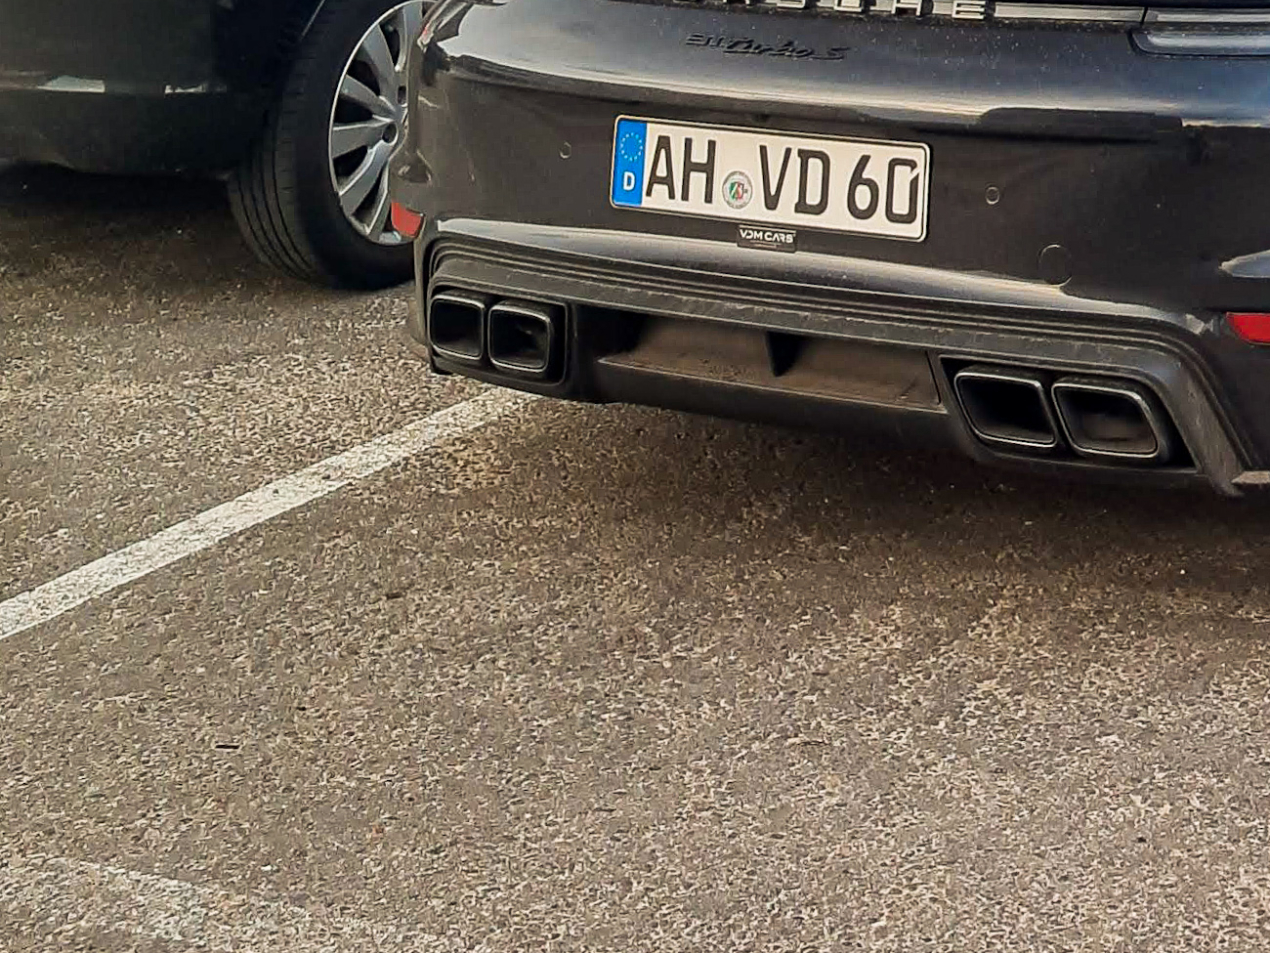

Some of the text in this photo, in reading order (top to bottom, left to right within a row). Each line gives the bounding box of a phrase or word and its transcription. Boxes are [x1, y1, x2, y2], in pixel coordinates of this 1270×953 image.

[623, 171, 636, 191] D
[645, 135, 717, 204] AH
[759, 144, 831, 216] VD
[846, 154, 919, 224] 60
[739, 229, 763, 241] VDM
